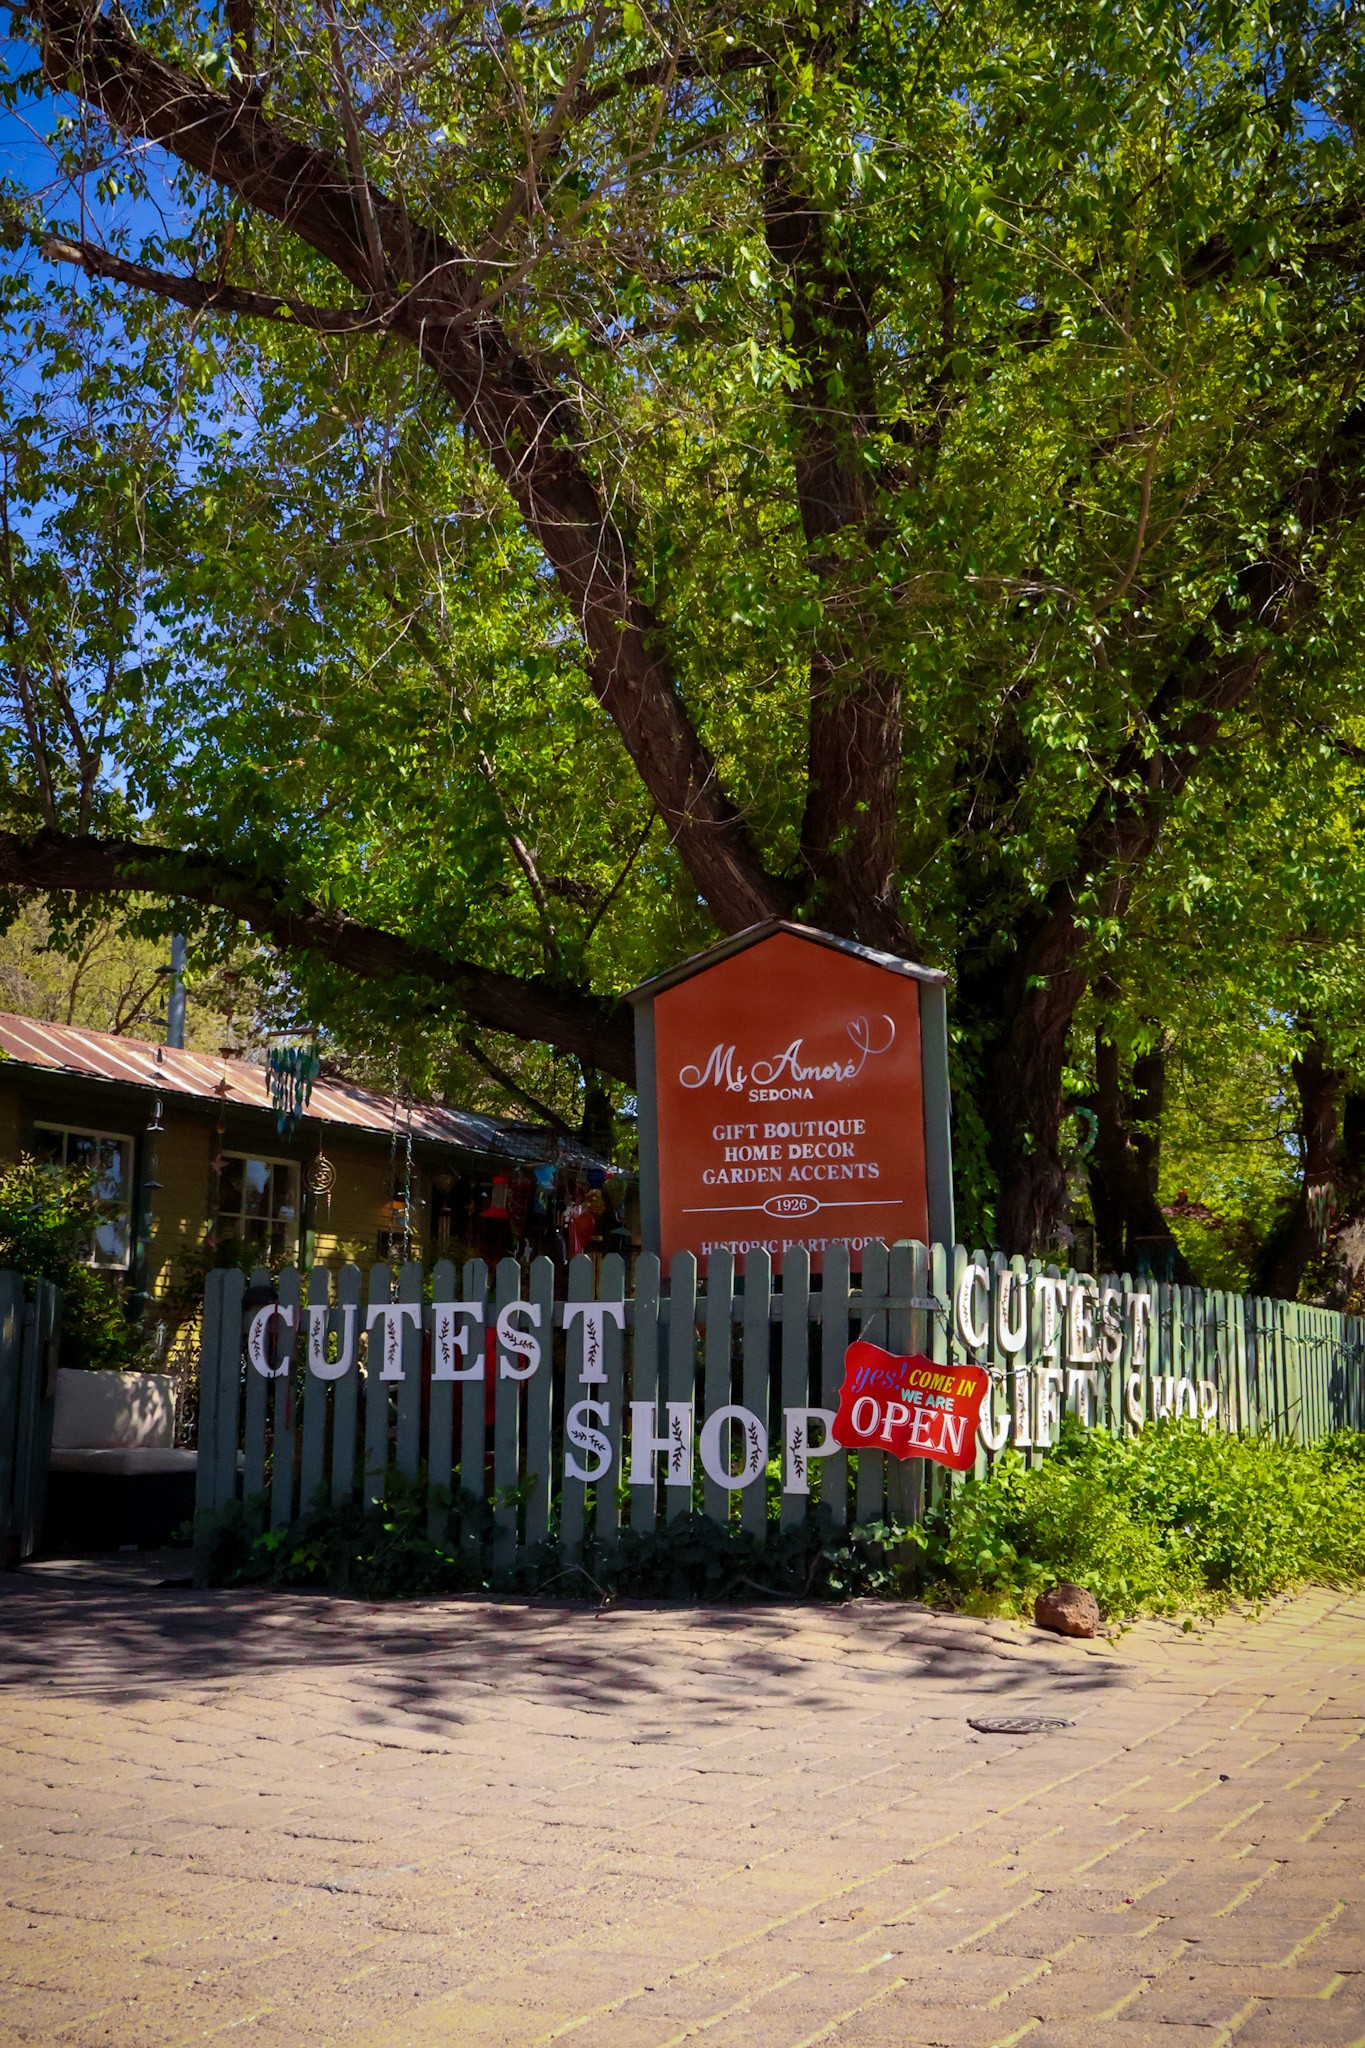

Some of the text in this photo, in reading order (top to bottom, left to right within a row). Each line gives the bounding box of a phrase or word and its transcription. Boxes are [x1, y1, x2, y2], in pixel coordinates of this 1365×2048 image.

[679, 1043, 748, 1092] Mi
[748, 1087, 815, 1103] SEDONA
[712, 1118, 867, 1141] GIFT BOUTIQUE
[724, 1141, 856, 1162] HOME DECOR
[702, 1162, 880, 1185] GARDEN ACCENTS
[775, 1199, 808, 1212] 1926
[958, 1264, 1151, 1366] CUTEST
[249, 1301, 625, 1384] CUTEST
[851, 1362, 977, 1398] yes! COME IN
[901, 1388, 955, 1412] WE ARE
[978, 1364, 1098, 1451] GIFT
[851, 1396, 969, 1456] OPEN
[564, 1400, 844, 1494] SHOP
